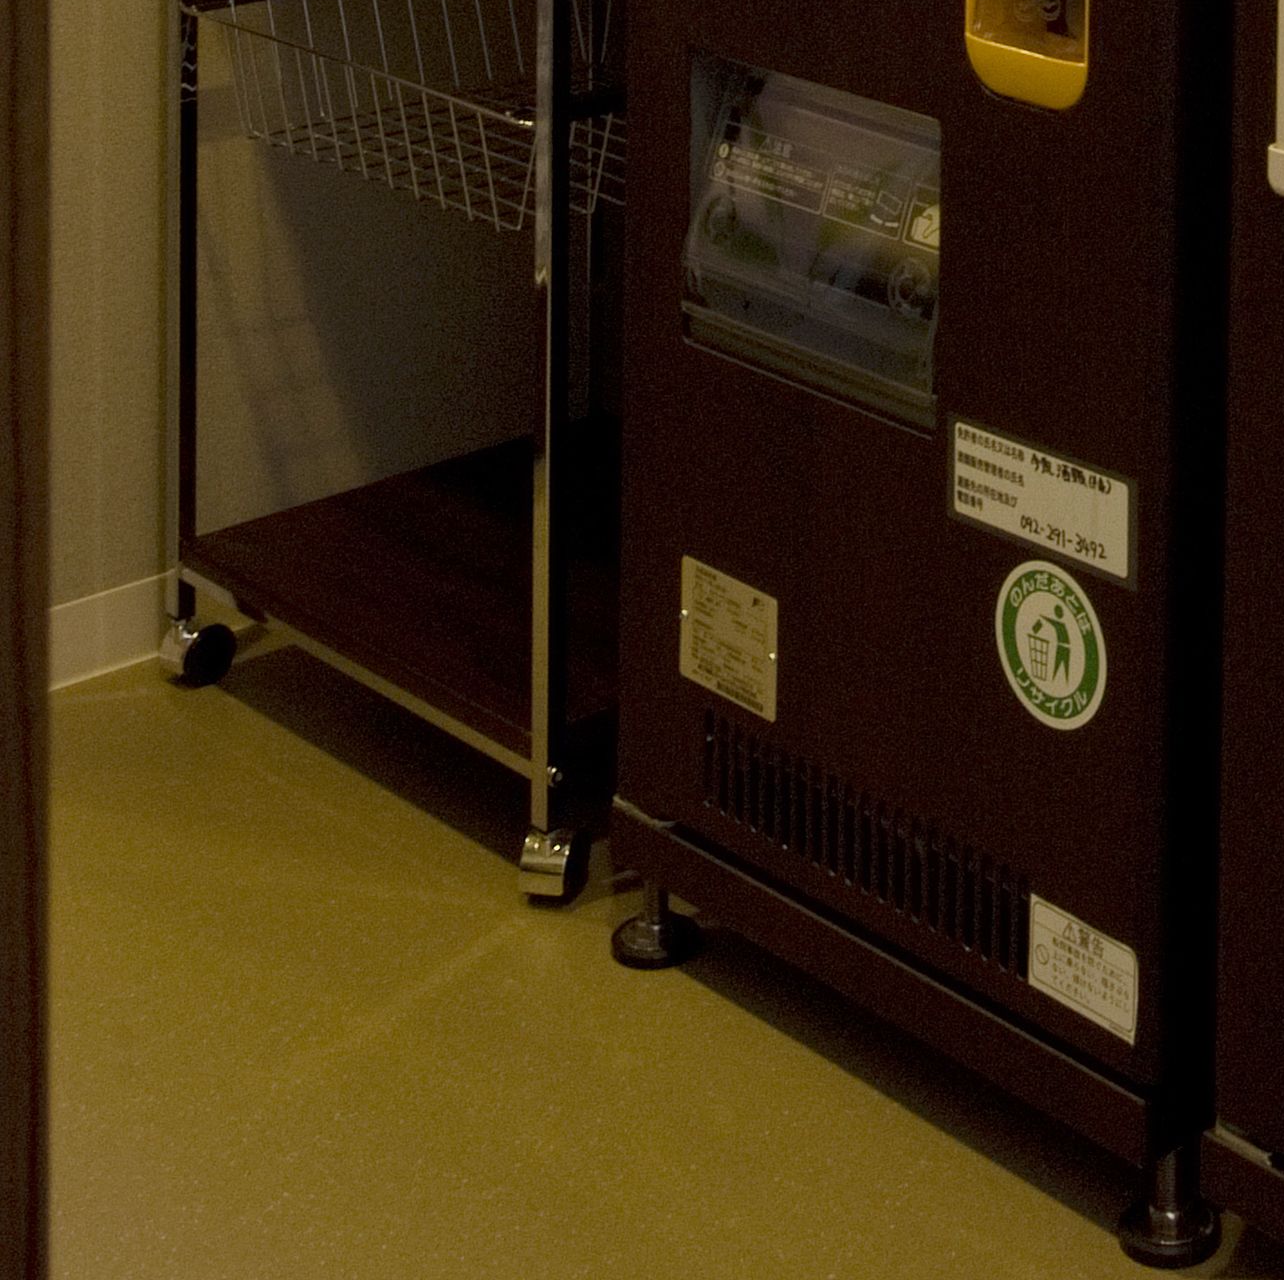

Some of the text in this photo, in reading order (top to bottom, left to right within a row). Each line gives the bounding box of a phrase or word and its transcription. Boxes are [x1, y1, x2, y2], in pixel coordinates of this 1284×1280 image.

[1010, 573, 1092, 636] のんだあとは
[1016, 666, 1088, 718] リサイクル
